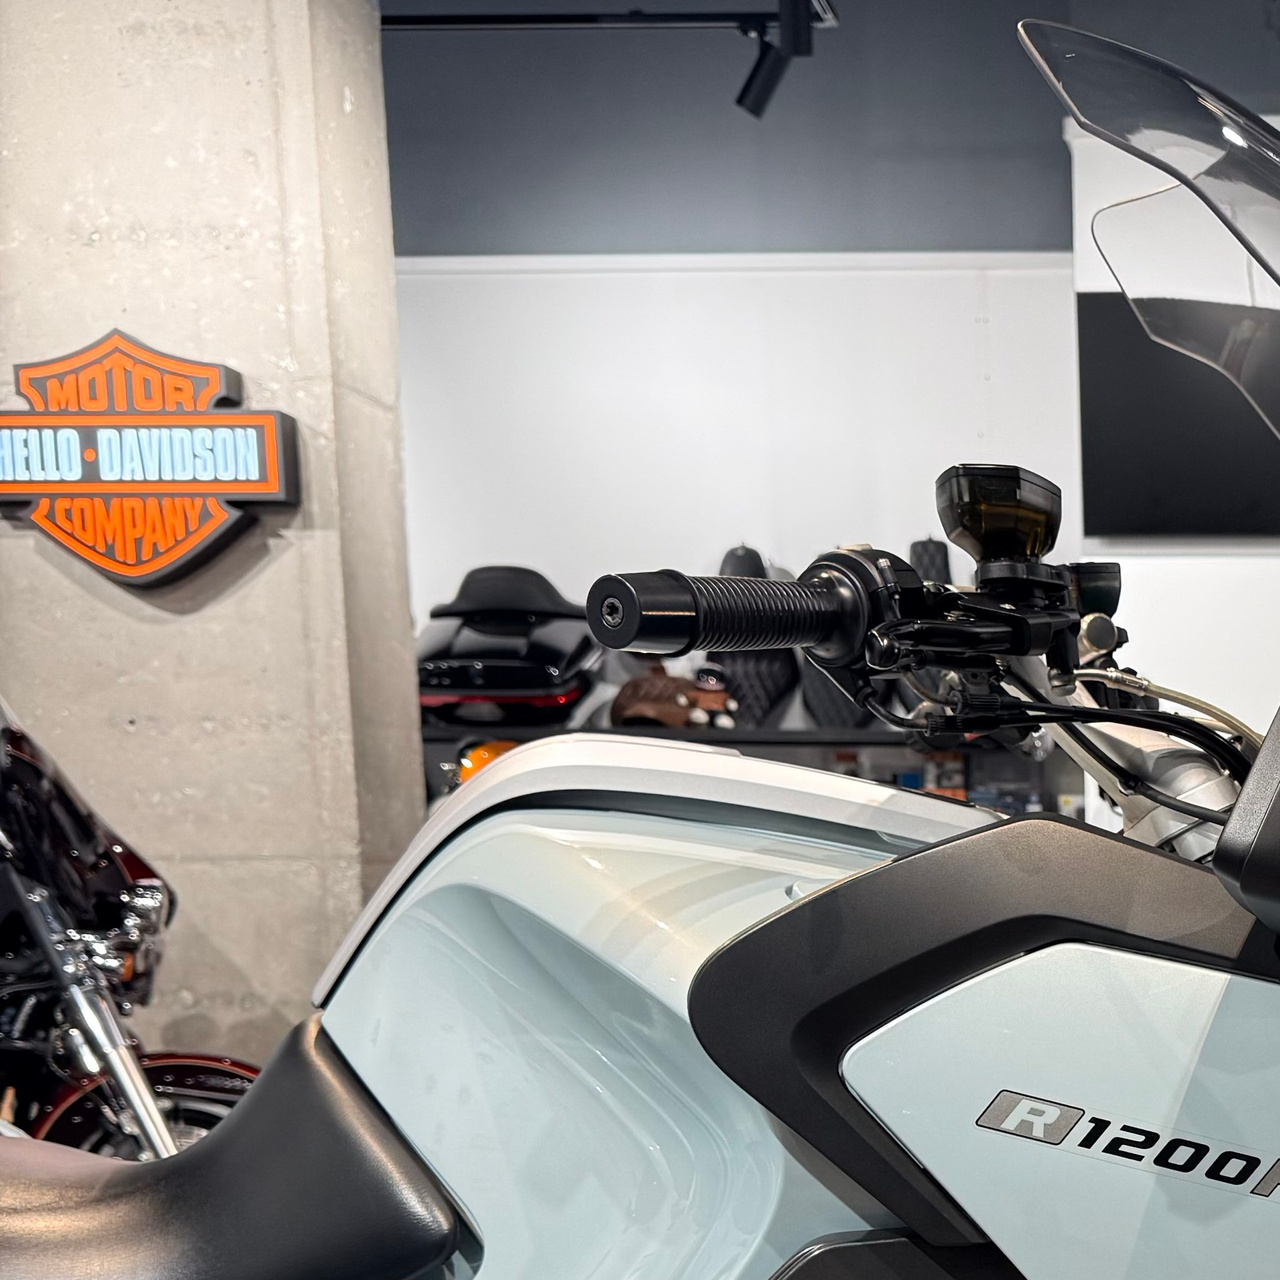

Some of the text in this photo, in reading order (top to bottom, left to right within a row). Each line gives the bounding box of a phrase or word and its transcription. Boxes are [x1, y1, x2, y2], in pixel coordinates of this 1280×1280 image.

[47, 351, 195, 411] MOTOR
[0, 428, 260, 481] HELLO DAVIDSON
[55, 497, 204, 564] COMPANY
